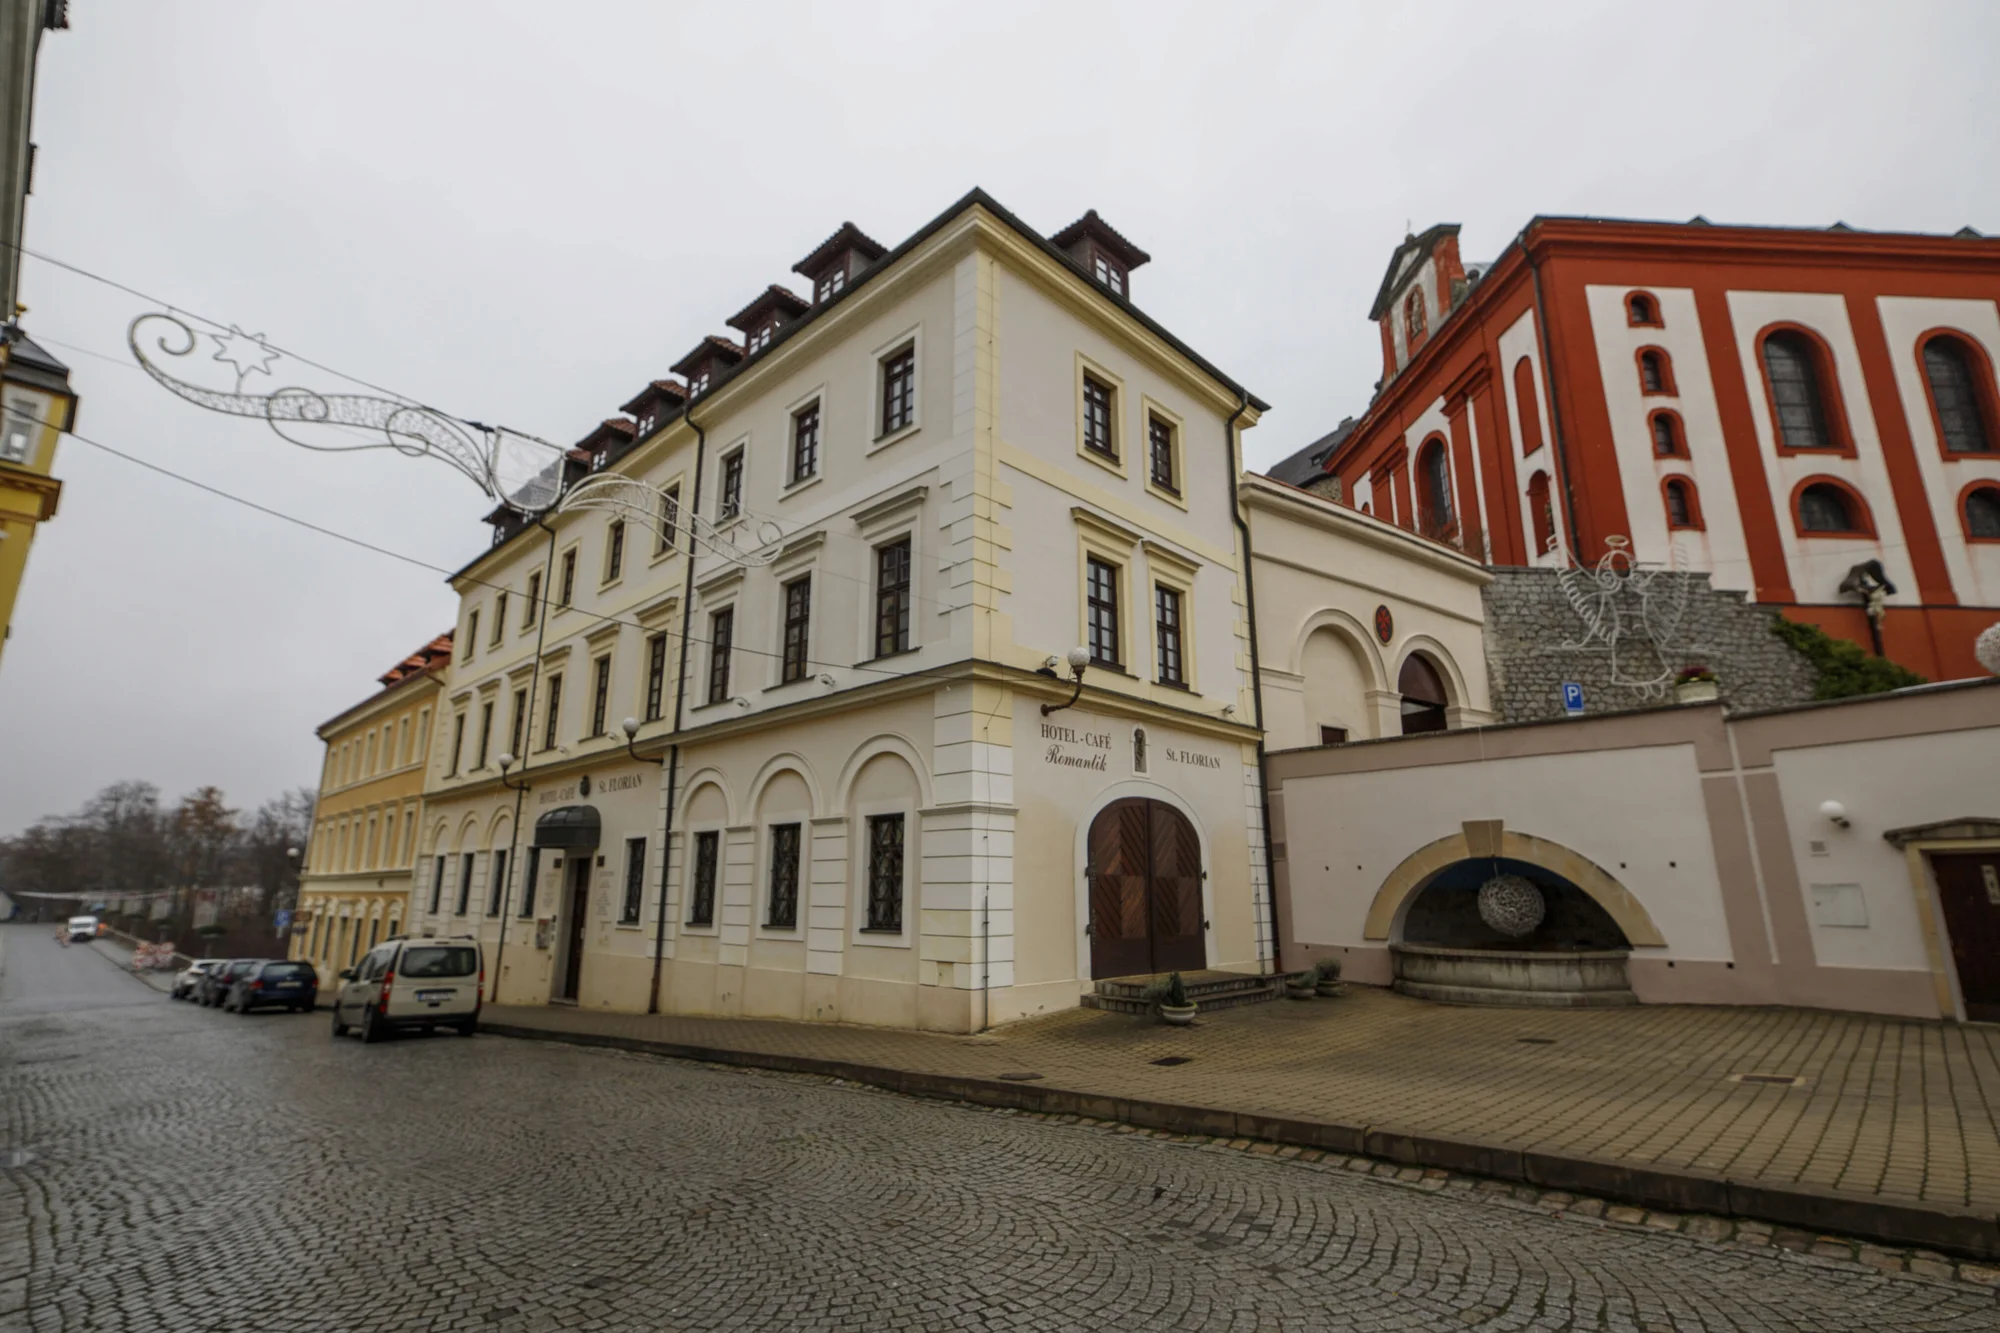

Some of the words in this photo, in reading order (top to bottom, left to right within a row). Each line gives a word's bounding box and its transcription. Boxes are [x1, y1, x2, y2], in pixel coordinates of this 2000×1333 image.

[1567, 686, 1579, 702] P
[1045, 744, 1108, 772] Romantik
[1166, 748, 1178, 762] St.
[1180, 750, 1221, 769] FLORIAN
[608, 773, 643, 792] FLORIAN
